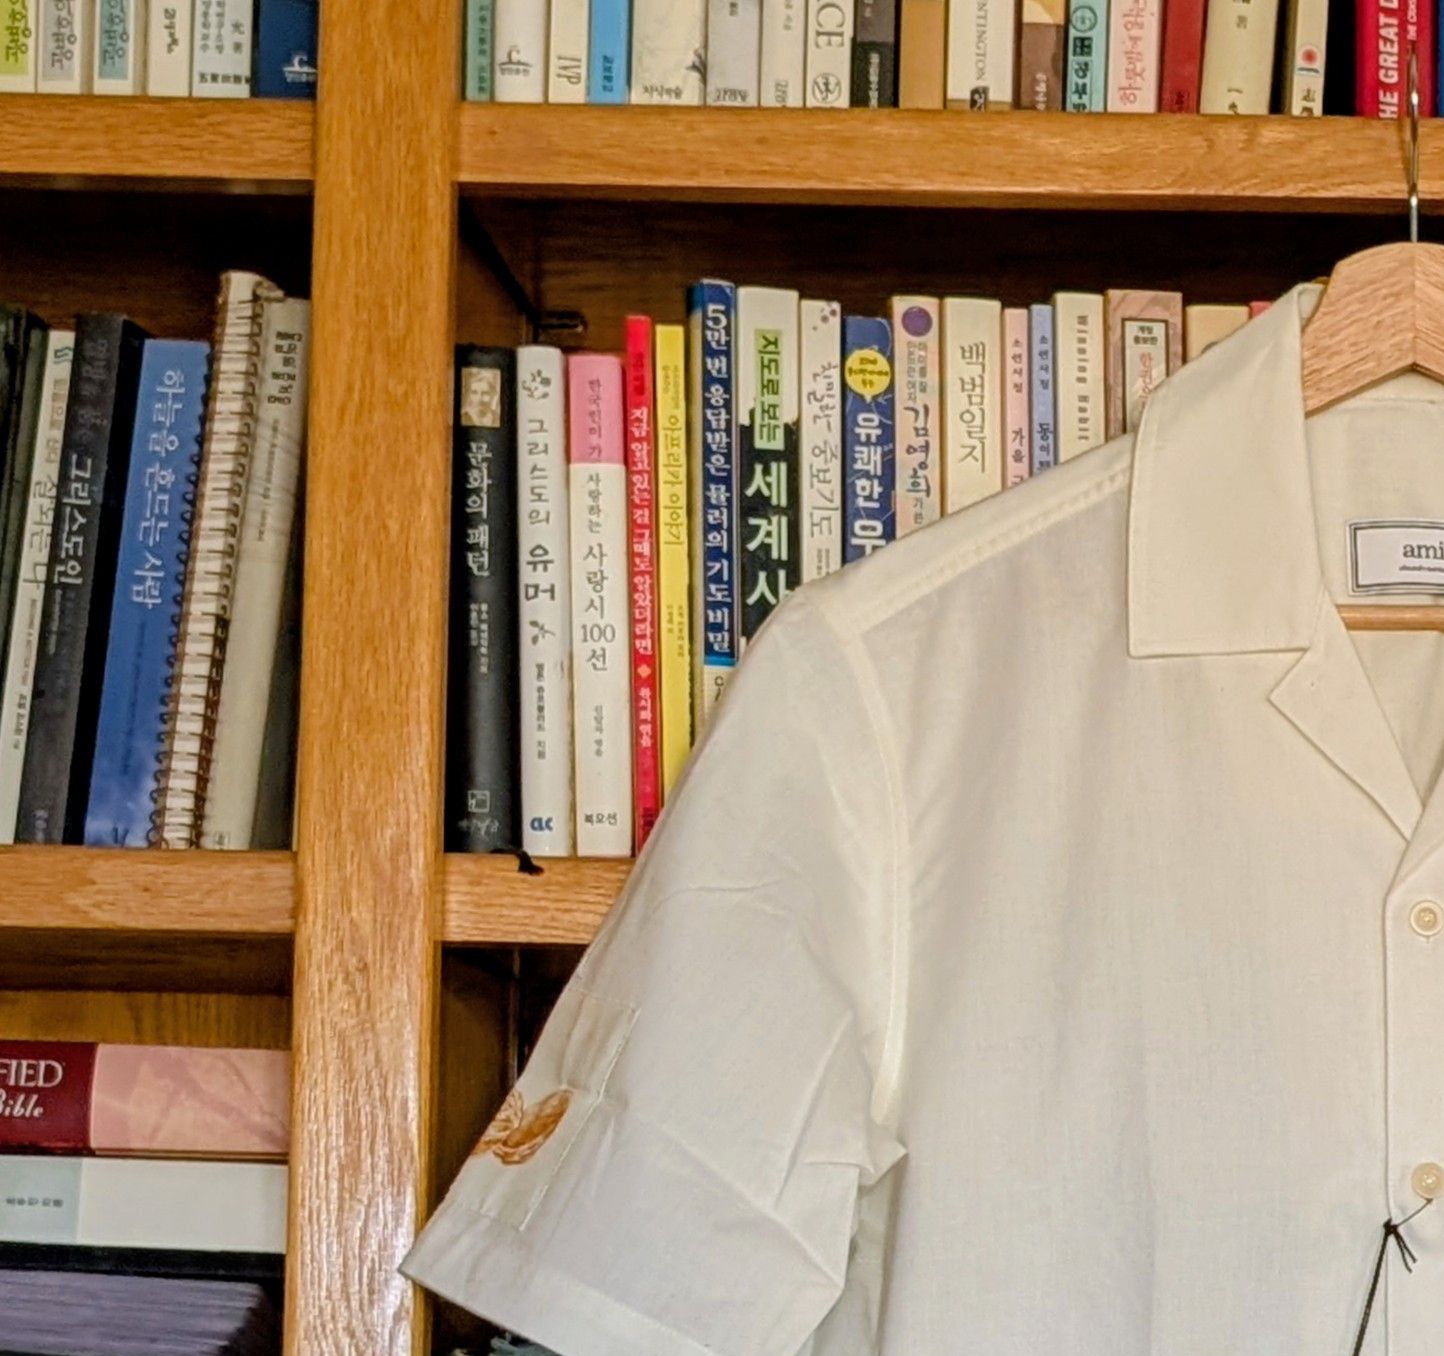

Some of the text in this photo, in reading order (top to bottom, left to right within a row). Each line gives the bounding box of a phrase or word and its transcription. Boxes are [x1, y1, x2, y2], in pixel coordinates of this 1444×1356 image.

[148, 370, 187, 456] 하늘을
[759, 336, 779, 444] 지도로 보는
[959, 341, 987, 474] 백범일지
[466, 442, 492, 521] 문화의
[662, 411, 682, 482] 아프리카
[137, 471, 180, 547] 흔드는
[524, 419, 556, 602] 그리스도의 유머
[664, 489, 684, 542] 이야기
[746, 460, 790, 606] 세계사
[131, 555, 164, 609] 사람
[466, 527, 492, 577] 패턴
[580, 542, 616, 672] 사랑시 100 선
